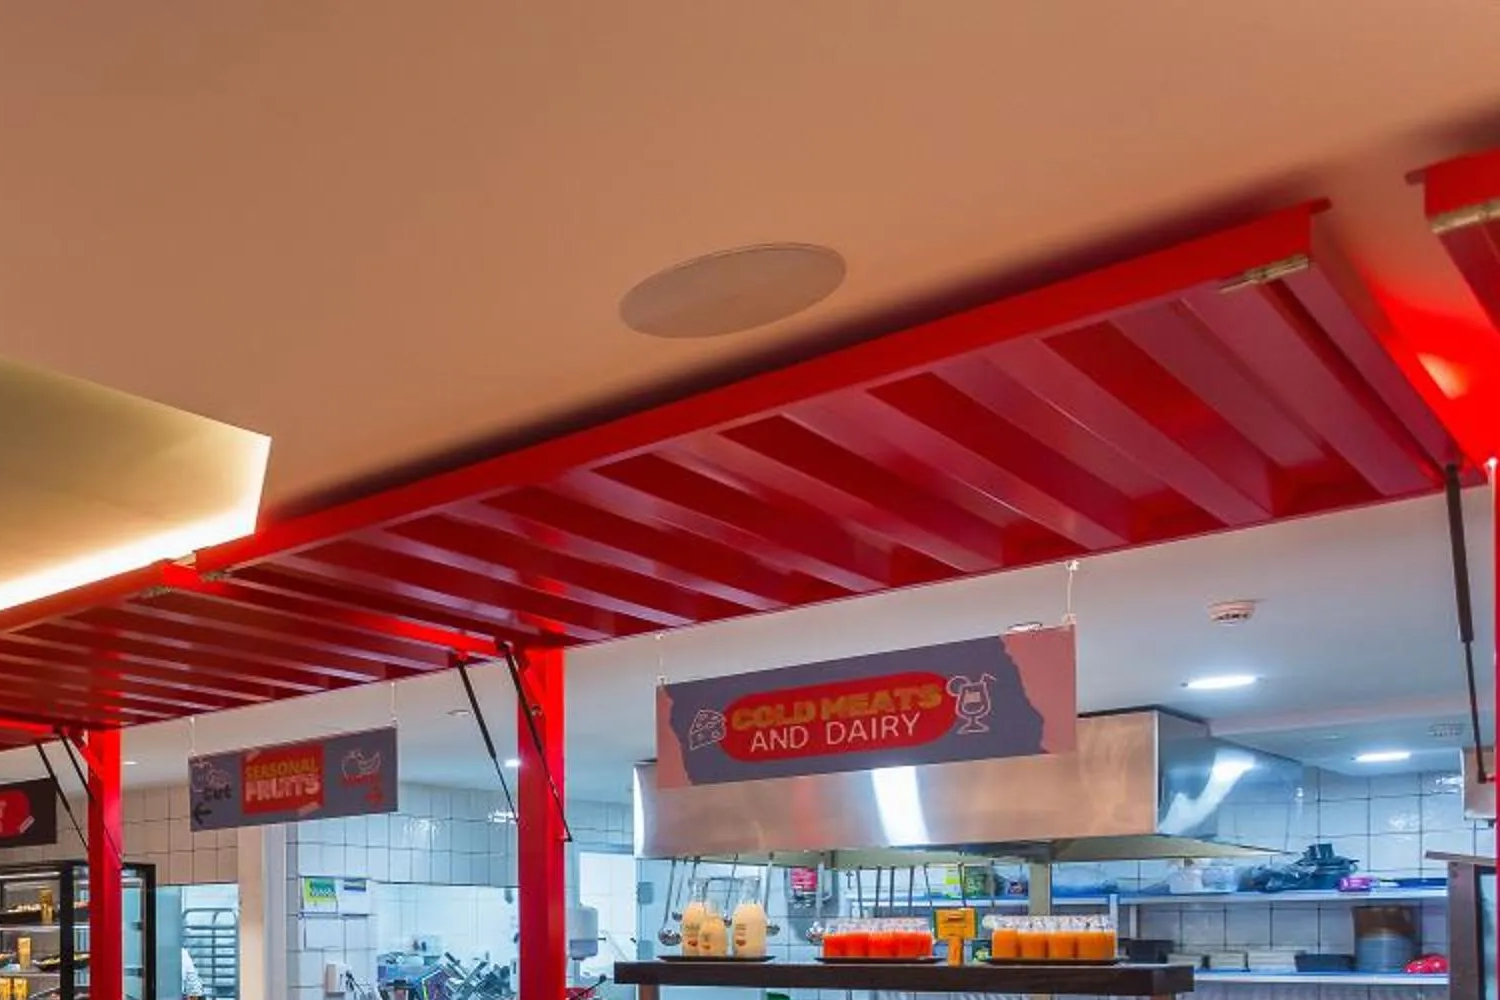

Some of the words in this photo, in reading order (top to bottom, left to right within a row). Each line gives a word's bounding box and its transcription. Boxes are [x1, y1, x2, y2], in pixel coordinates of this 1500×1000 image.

[820, 683, 943, 721] MEATS
[750, 725, 809, 752] AND
[825, 711, 921, 745] DAIRY
[245, 756, 319, 780] SEASONAL
[245, 773, 321, 802] FRUITS
